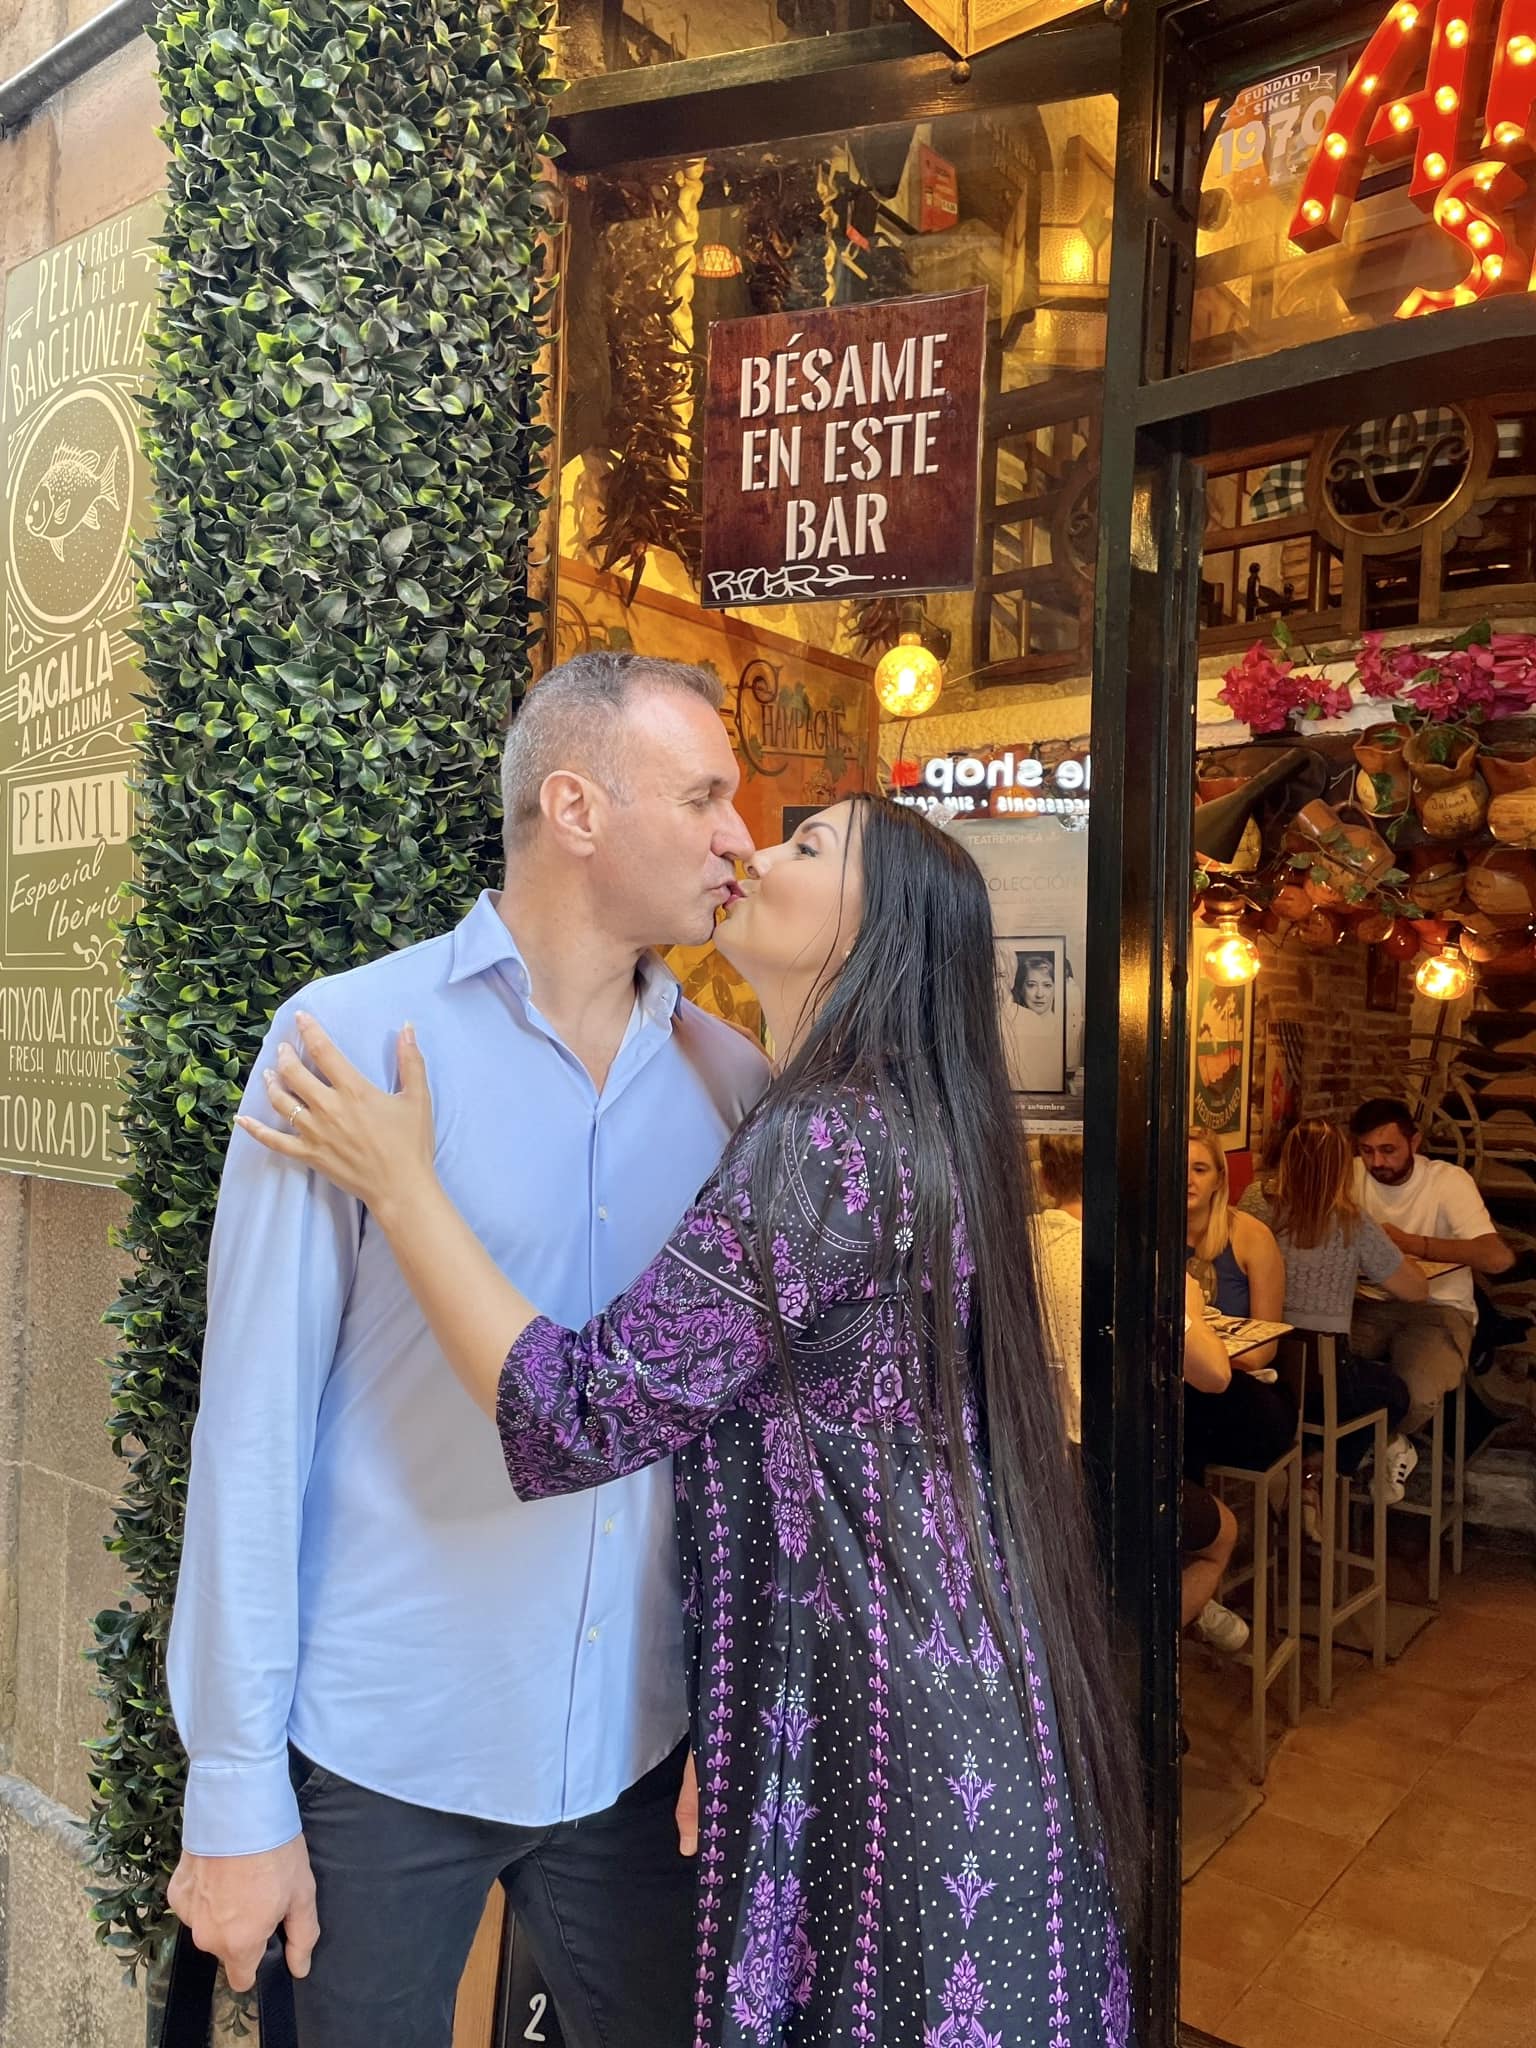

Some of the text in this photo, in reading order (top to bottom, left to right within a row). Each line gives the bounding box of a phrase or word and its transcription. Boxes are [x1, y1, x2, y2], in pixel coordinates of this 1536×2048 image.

[1245, 71, 1312, 104] FUNDADO
[1253, 89, 1300, 115] SINCE
[1219, 95, 1336, 176] 1970
[36, 216, 133, 329] PEIX FREGIT
[92, 258, 125, 304] DE LA
[11, 301, 151, 416] BARCELONETA
[739, 332, 948, 419] BÉSAME
[741, 410, 941, 492] EN ESTE
[785, 492, 888, 561] BAR
[18, 619, 114, 724] BACALLÀ
[21, 688, 112, 757] A LA LLAUNA
[19, 780, 121, 845] PERNIL
[10, 841, 106, 917] Especial
[984, 871, 1078, 892] OLECCIÓN
[48, 886, 121, 941] Ibèric
[70, 986, 131, 1047] FRESC
[9, 1045, 121, 1081] FRESH ANCHOVIES
[523, 1993, 547, 2042] 2
